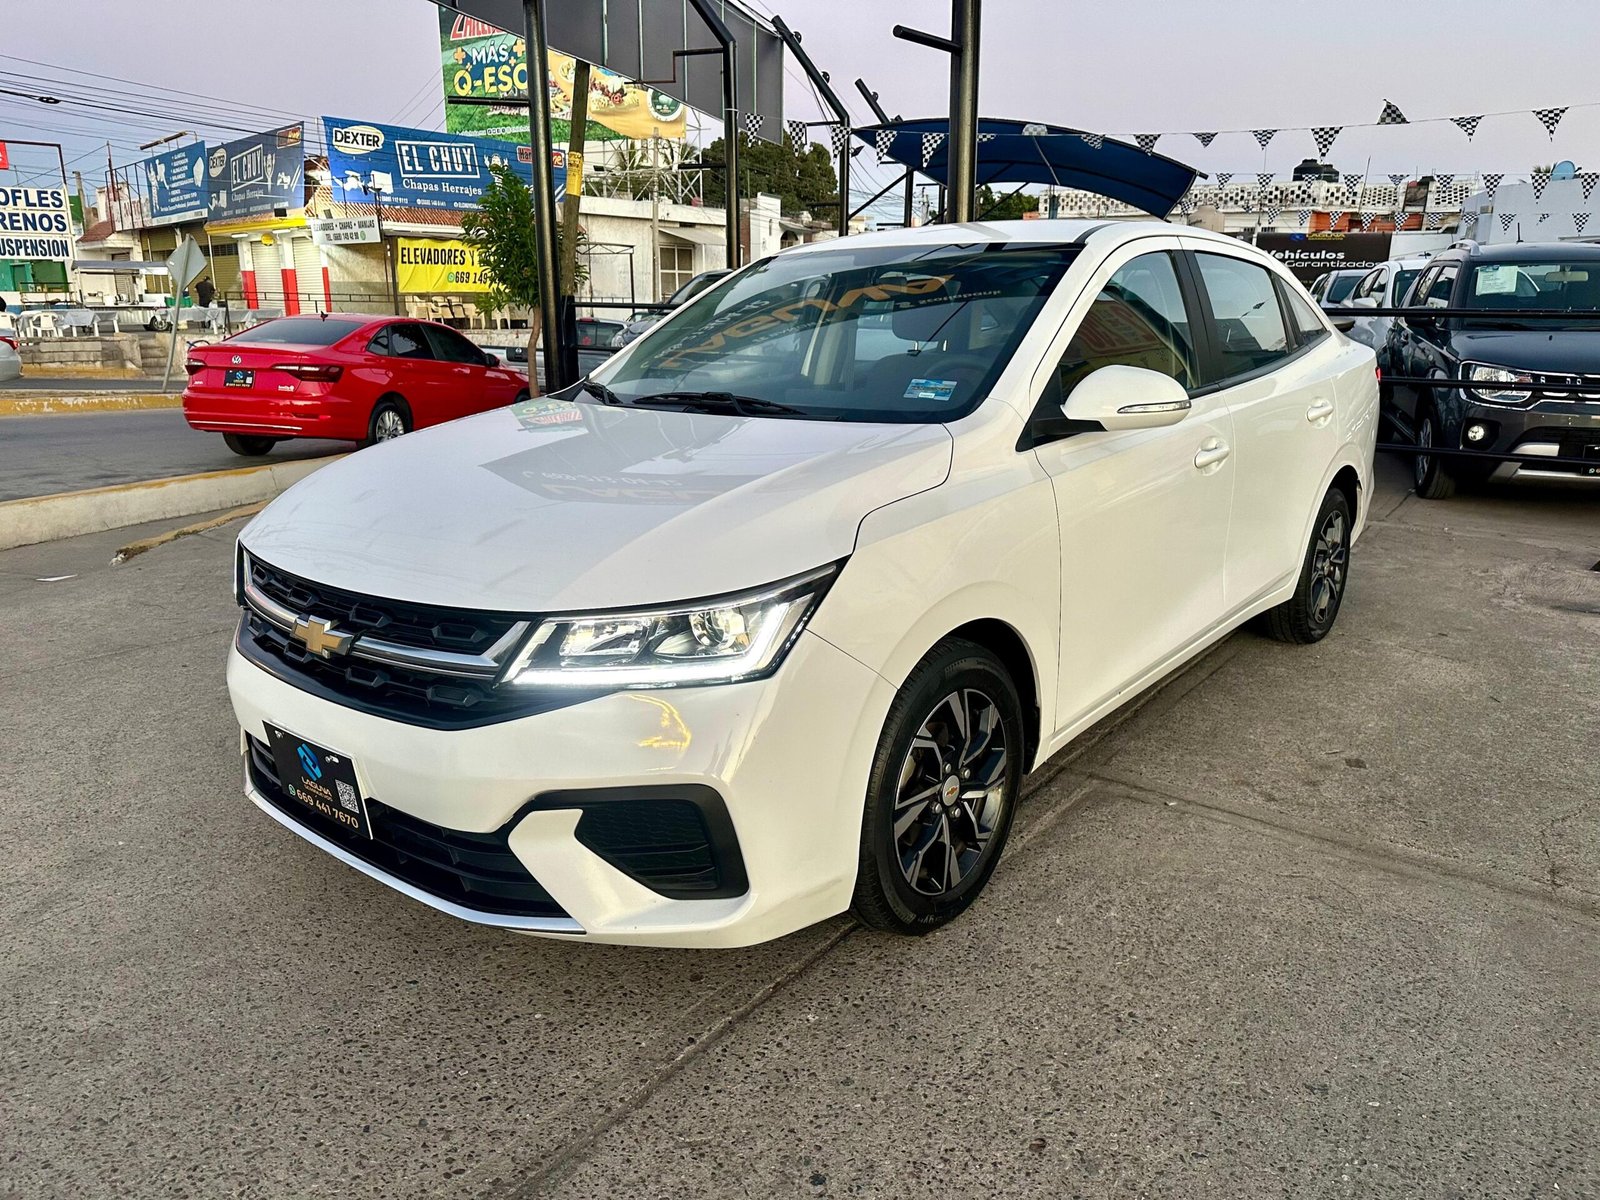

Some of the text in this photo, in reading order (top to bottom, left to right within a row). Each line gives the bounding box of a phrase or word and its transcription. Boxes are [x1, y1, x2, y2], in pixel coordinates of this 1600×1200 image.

[471, 40, 509, 65] MÁS
[334, 129, 380, 147] DEXTER
[232, 148, 261, 185] EL CHUY
[401, 144, 472, 172] EL CHUY
[402, 178, 483, 197] Chapas Herrajes
[401, 247, 466, 266] ELEVADORES
[468, 250, 475, 266] Y
[455, 271, 470, 284] 669
[296, 789, 359, 829] 669 441 7670
